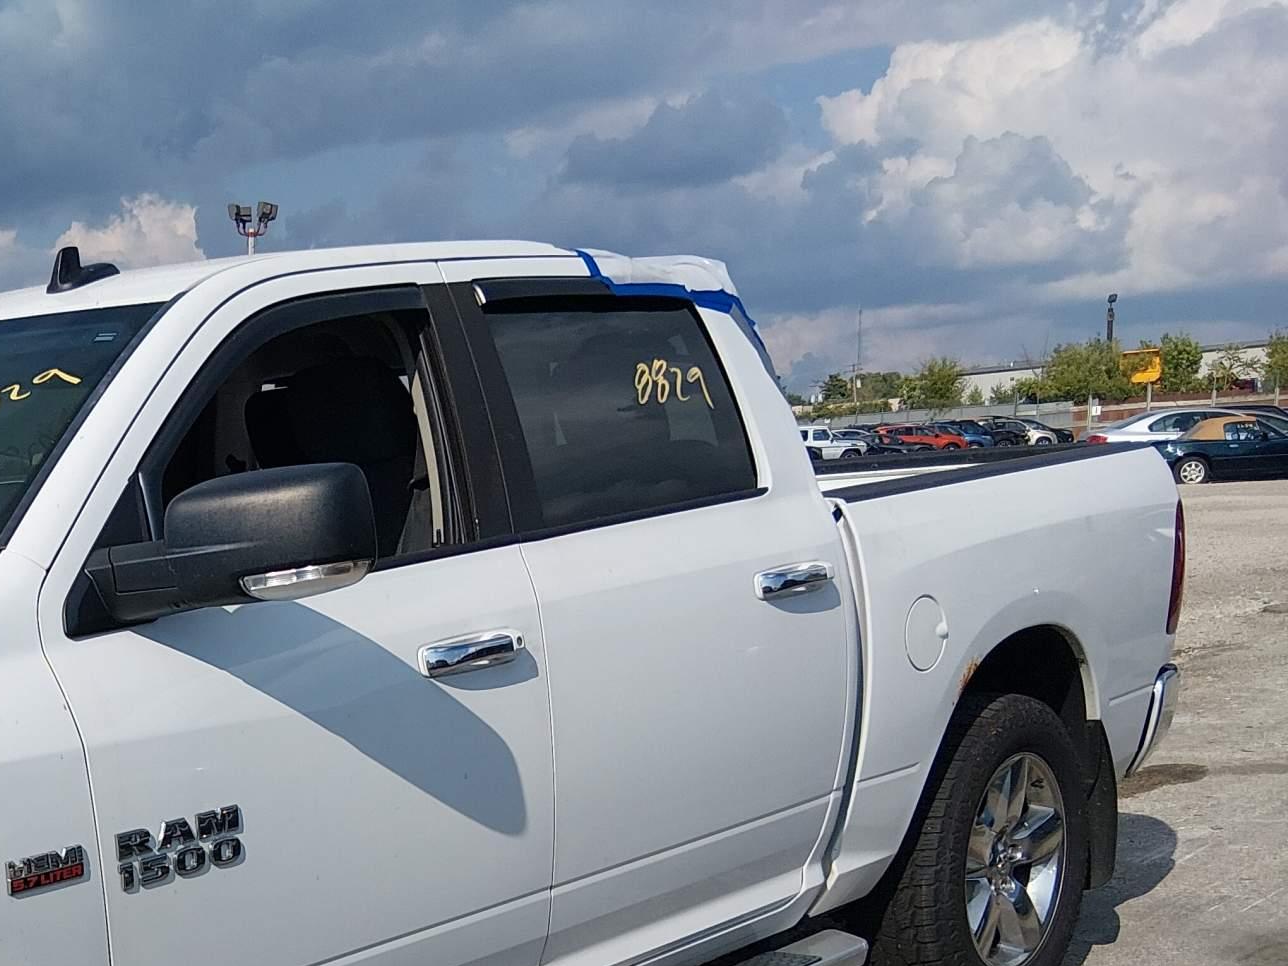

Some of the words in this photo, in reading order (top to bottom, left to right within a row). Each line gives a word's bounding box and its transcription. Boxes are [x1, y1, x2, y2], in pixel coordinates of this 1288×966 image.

[635, 358, 715, 410] 8829
[114, 804, 242, 863] RAM
[5, 844, 84, 880] HEMI
[12, 876, 39, 892] 5.7
[40, 863, 83, 885] LITER
[119, 837, 244, 893] 1500
